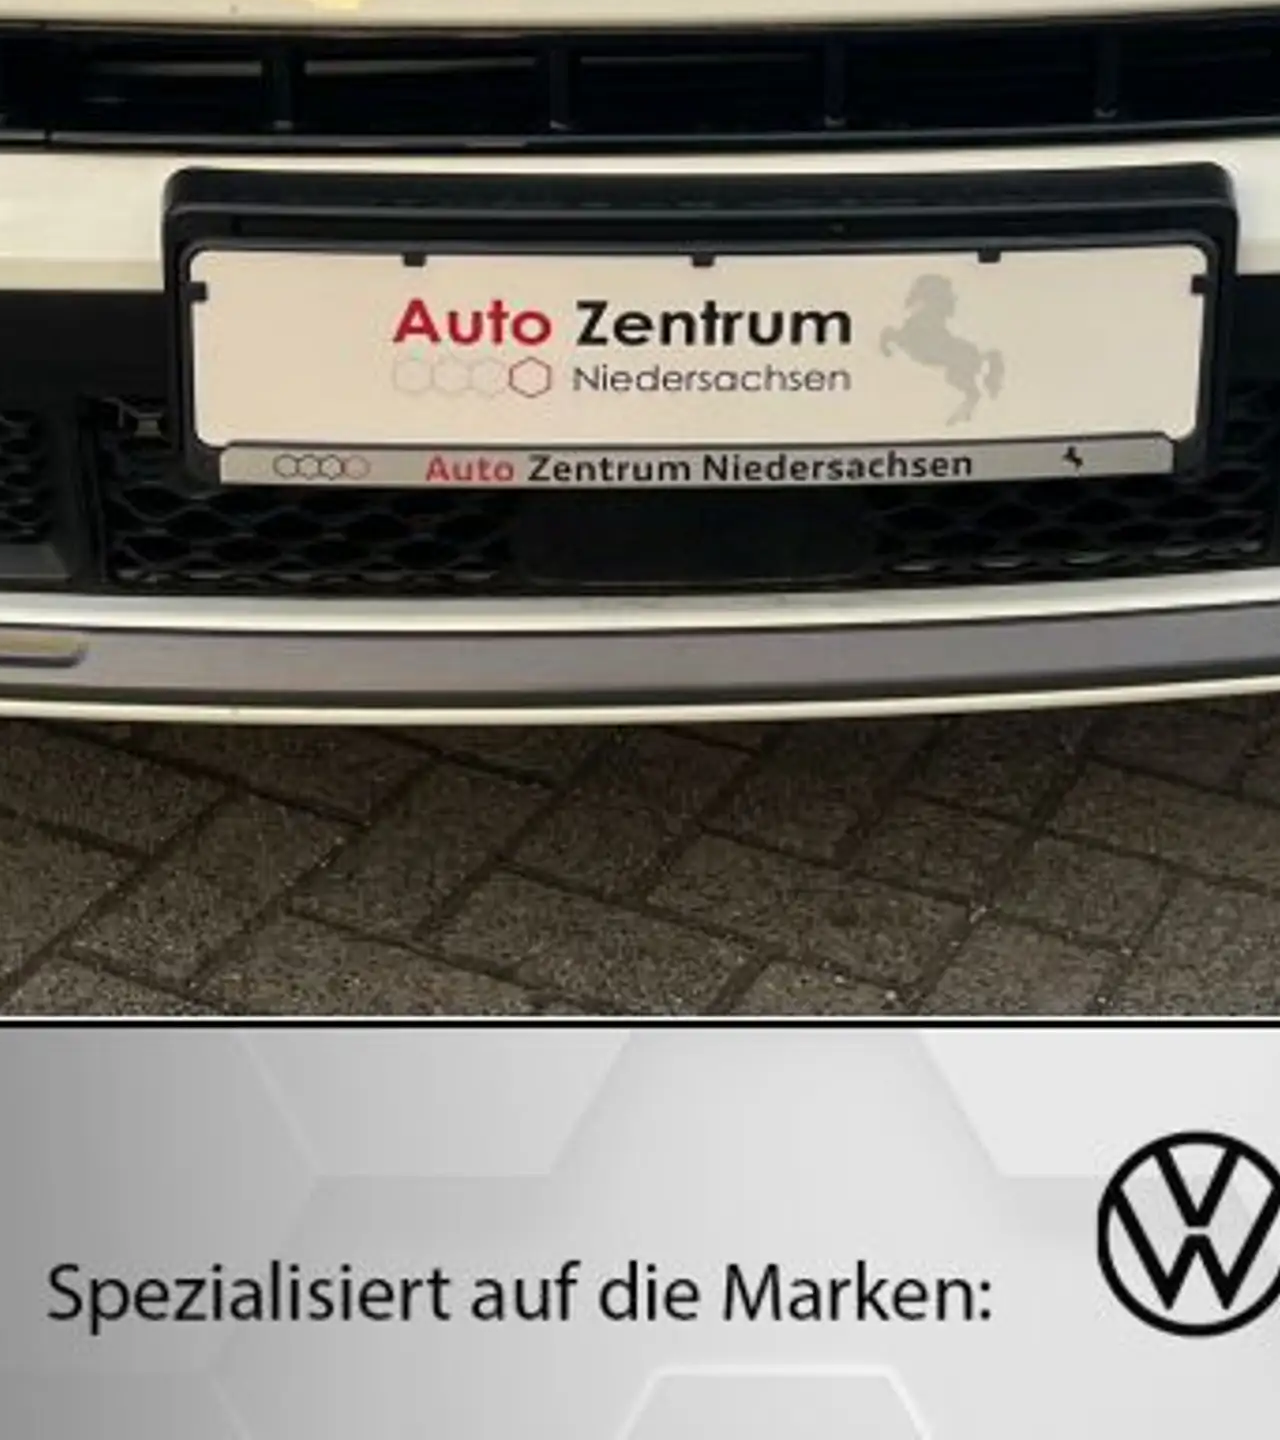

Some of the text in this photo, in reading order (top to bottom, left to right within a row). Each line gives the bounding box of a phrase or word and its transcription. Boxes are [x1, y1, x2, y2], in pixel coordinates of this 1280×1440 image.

[393, 298, 852, 347] Auto Zentrum
[573, 363, 851, 394] Niedersachsen
[424, 448, 974, 484] Auto Zentrum Niedersachsen
